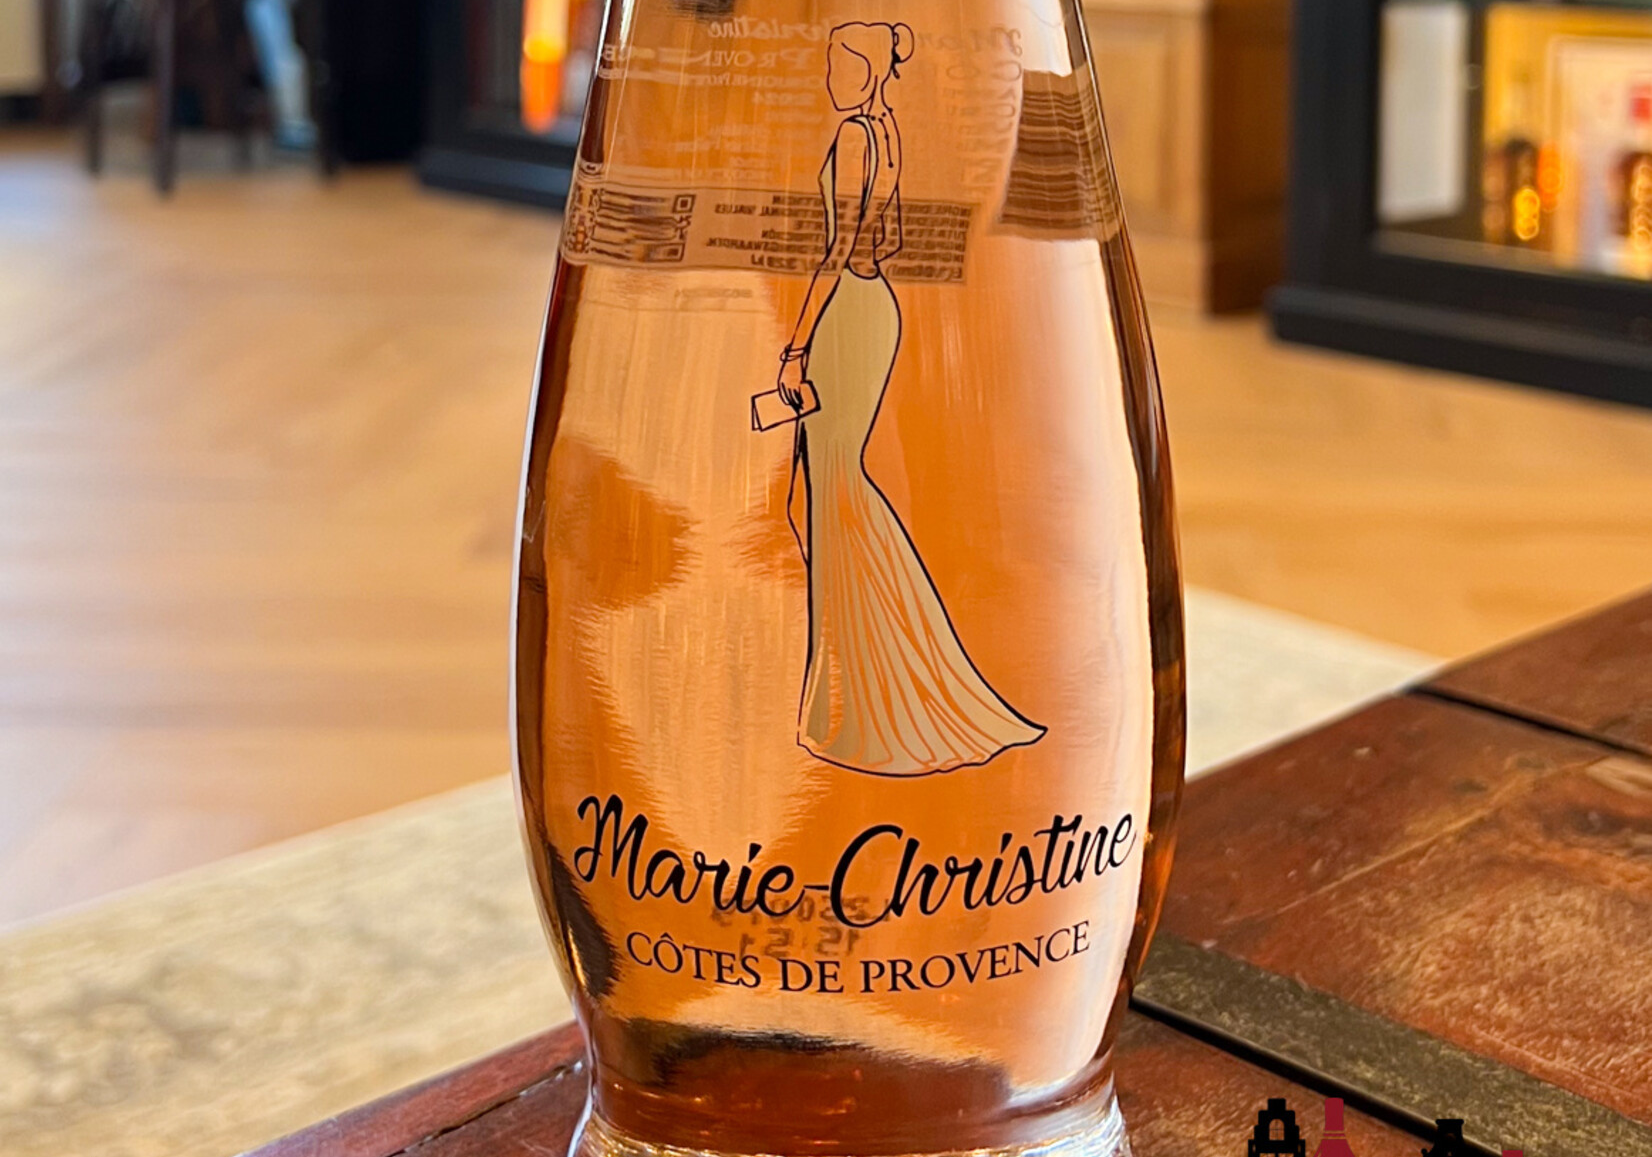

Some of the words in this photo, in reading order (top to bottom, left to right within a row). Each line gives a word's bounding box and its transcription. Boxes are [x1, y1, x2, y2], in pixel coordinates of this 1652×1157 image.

[574, 794, 1137, 927] Marie-Christine
[626, 931, 762, 989] CÔTES
[779, 957, 844, 993] DE
[859, 920, 1091, 993] PROVENCE
